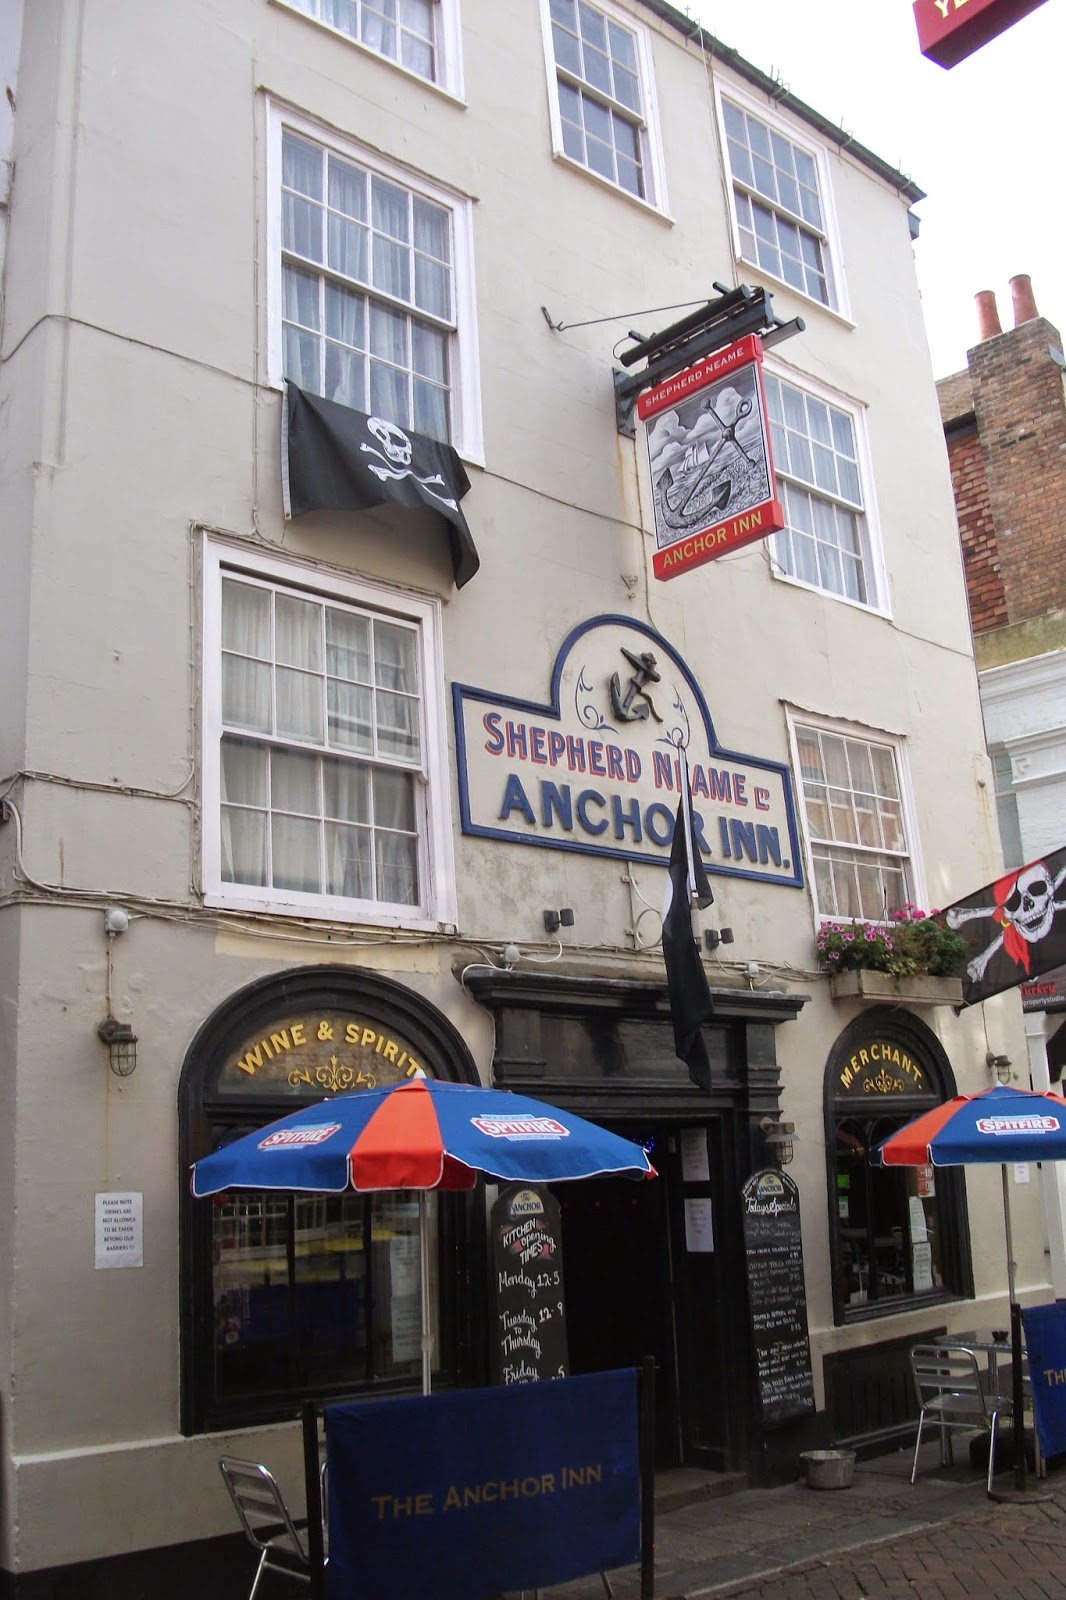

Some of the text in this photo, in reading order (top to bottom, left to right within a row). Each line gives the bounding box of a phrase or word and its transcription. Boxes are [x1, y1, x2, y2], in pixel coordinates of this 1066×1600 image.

[645, 348, 745, 407] SHEPHERD NEAME
[662, 511, 763, 568] ANCHOR INN
[482, 712, 642, 783] SHEPHERD
[718, 815, 791, 869] INN.
[237, 1020, 423, 1077] WINE & SPIRIT
[264, 1126, 336, 1146] SPITFIRE
[478, 1119, 562, 1134] SPITFIRE
[982, 1118, 1052, 1131] SPITFIRE
[514, 1202, 541, 1212] ANCHOR
[503, 1217, 536, 1248] KITCHEN
[520, 1229, 557, 1253] opening
[520, 1240, 543, 1265] TIMES
[499, 1268, 538, 1299] Monday
[499, 1308, 538, 1333] Tuesday
[501, 1330, 542, 1359] Thursday
[503, 1359, 540, 1386] Friday
[371, 1465, 602, 1521] THE ANCHOR INN
